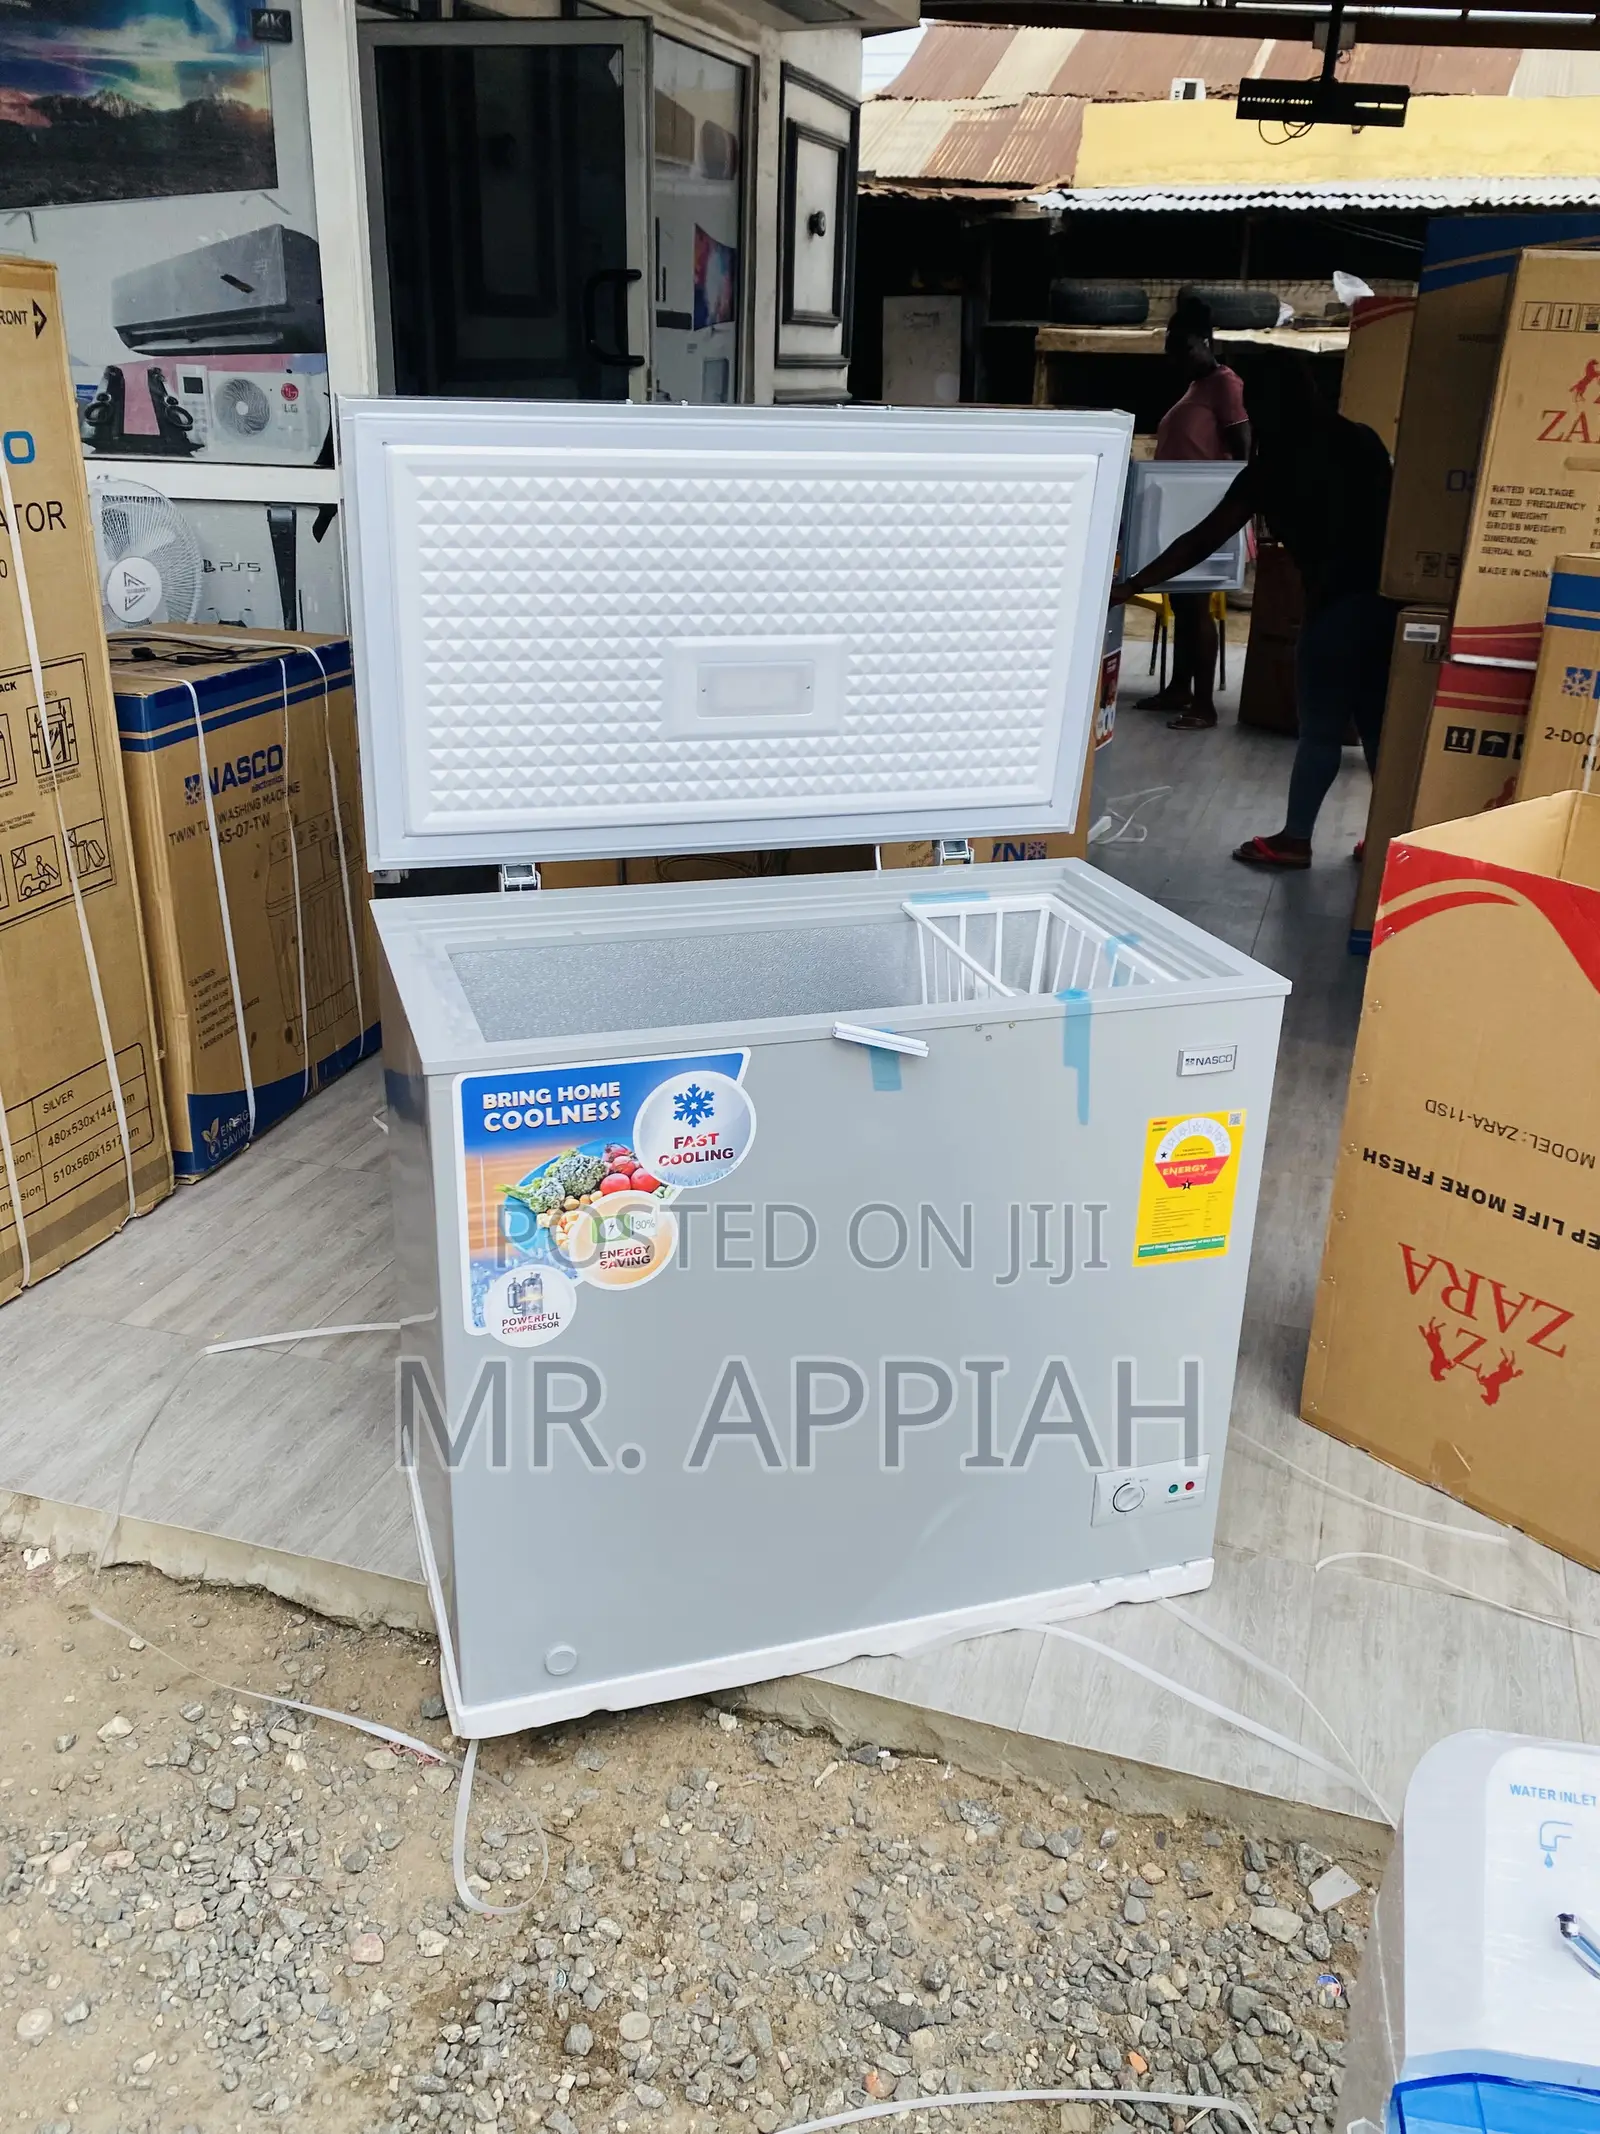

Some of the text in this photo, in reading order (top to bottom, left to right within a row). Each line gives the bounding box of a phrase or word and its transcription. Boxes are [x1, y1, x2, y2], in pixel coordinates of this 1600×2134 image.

[1536, 409, 1600, 444] ZA
[3, 431, 36, 465] O
[1492, 484, 1525, 495] RATED
[1490, 496, 1522, 507] RATED
[219, 561, 262, 573] PS5
[1478, 565, 1508, 576] MADE
[1510, 568, 1521, 576] IN
[1195, 1053, 1233, 1066] NASCO
[43, 1089, 75, 1114] SILVER
[482, 1081, 621, 1110] BRING HOME
[483, 1100, 621, 1132] COOLNESS
[1425, 1099, 1519, 1142] ZARA-11SD
[673, 1131, 720, 1150] FAST
[658, 1148, 734, 1167] COOLING
[1362, 1147, 1434, 1186] FRESH
[1163, 1164, 1208, 1176] ENERGY
[1440, 1176, 1506, 1213] MORE
[635, 1217, 656, 1230] 30%
[1513, 1203, 1565, 1237] LIFE
[600, 1245, 651, 1260] ENERGY
[600, 1254, 652, 1270] SAVING
[1398, 1242, 1575, 1358] ZARA
[501, 1312, 561, 1328] POWERFUL
[501, 1320, 560, 1335] COMPRESSOR
[1509, 1783, 1597, 1808] WATER INLET
